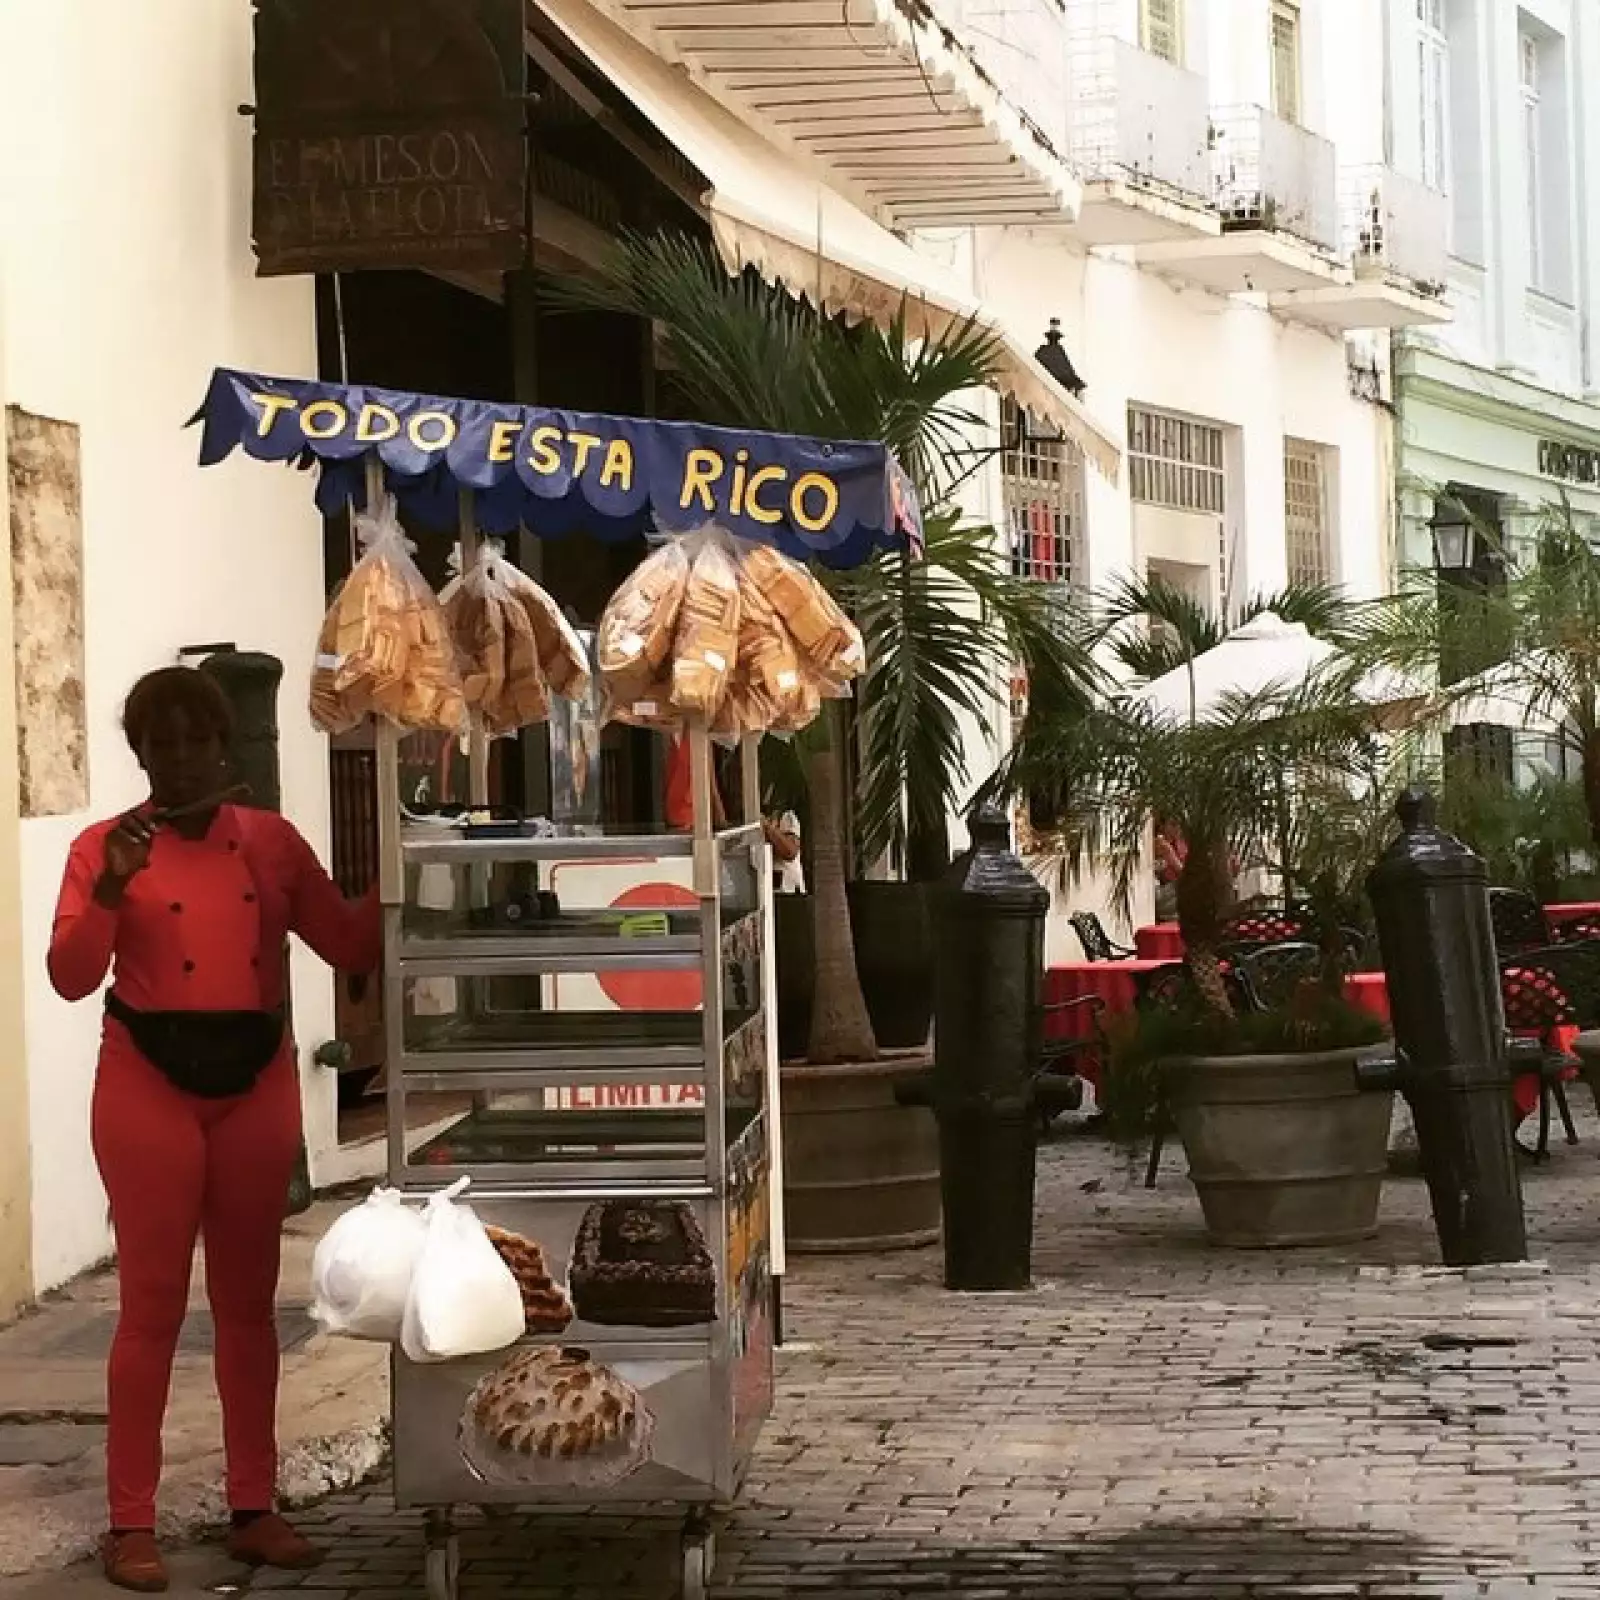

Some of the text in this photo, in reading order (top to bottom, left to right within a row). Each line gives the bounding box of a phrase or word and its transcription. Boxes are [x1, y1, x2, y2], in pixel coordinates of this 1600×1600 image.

[322, 130, 496, 183] MESON
[251, 393, 457, 451] TODO
[489, 421, 634, 491] ESTA
